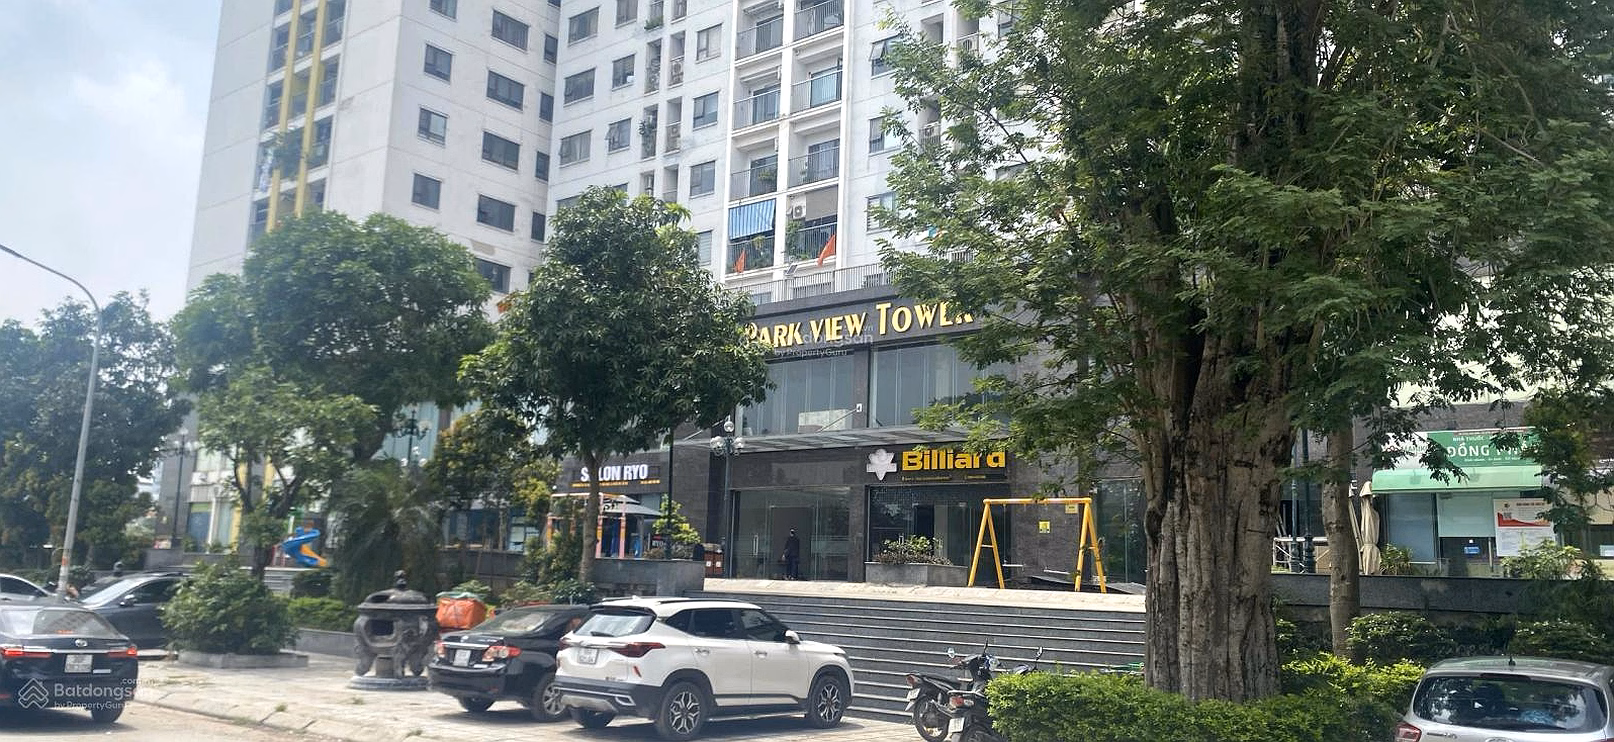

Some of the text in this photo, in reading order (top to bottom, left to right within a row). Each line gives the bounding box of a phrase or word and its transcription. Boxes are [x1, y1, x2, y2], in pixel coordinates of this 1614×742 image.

[810, 311, 867, 342] VIEW
[580, 464, 648, 482] SLON RYO
